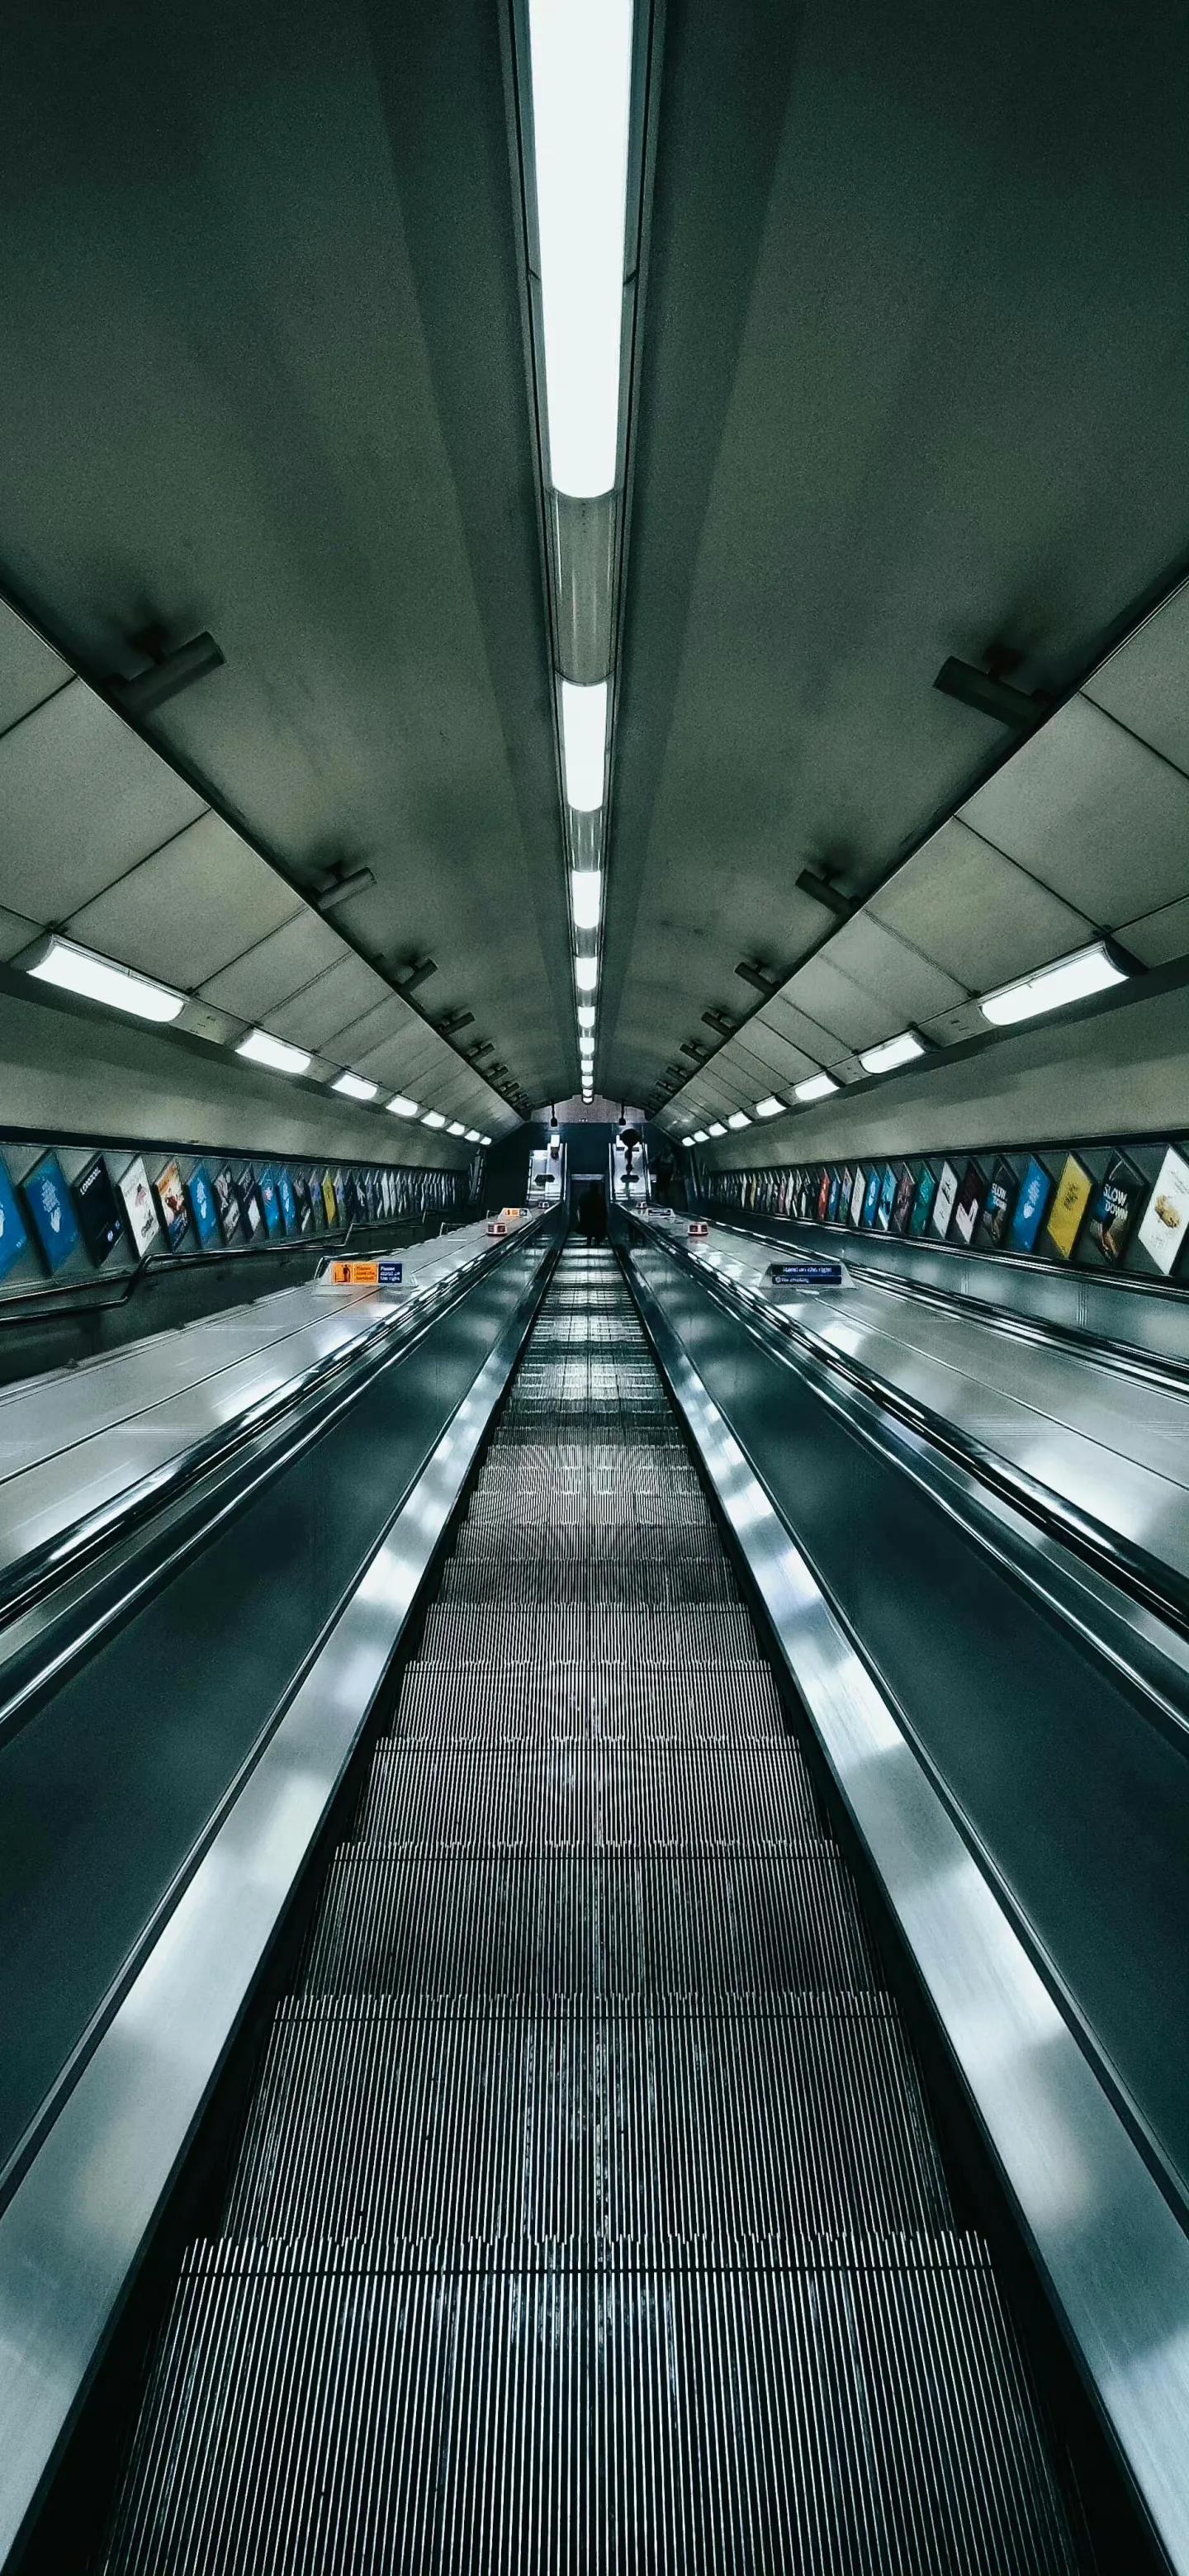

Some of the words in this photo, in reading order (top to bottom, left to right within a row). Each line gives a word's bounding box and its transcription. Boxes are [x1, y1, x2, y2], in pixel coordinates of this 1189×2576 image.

[991, 1183, 1007, 1200] SLOW
[1103, 1184, 1128, 1206] SLOW
[1105, 1200, 1128, 1219] DOWN
